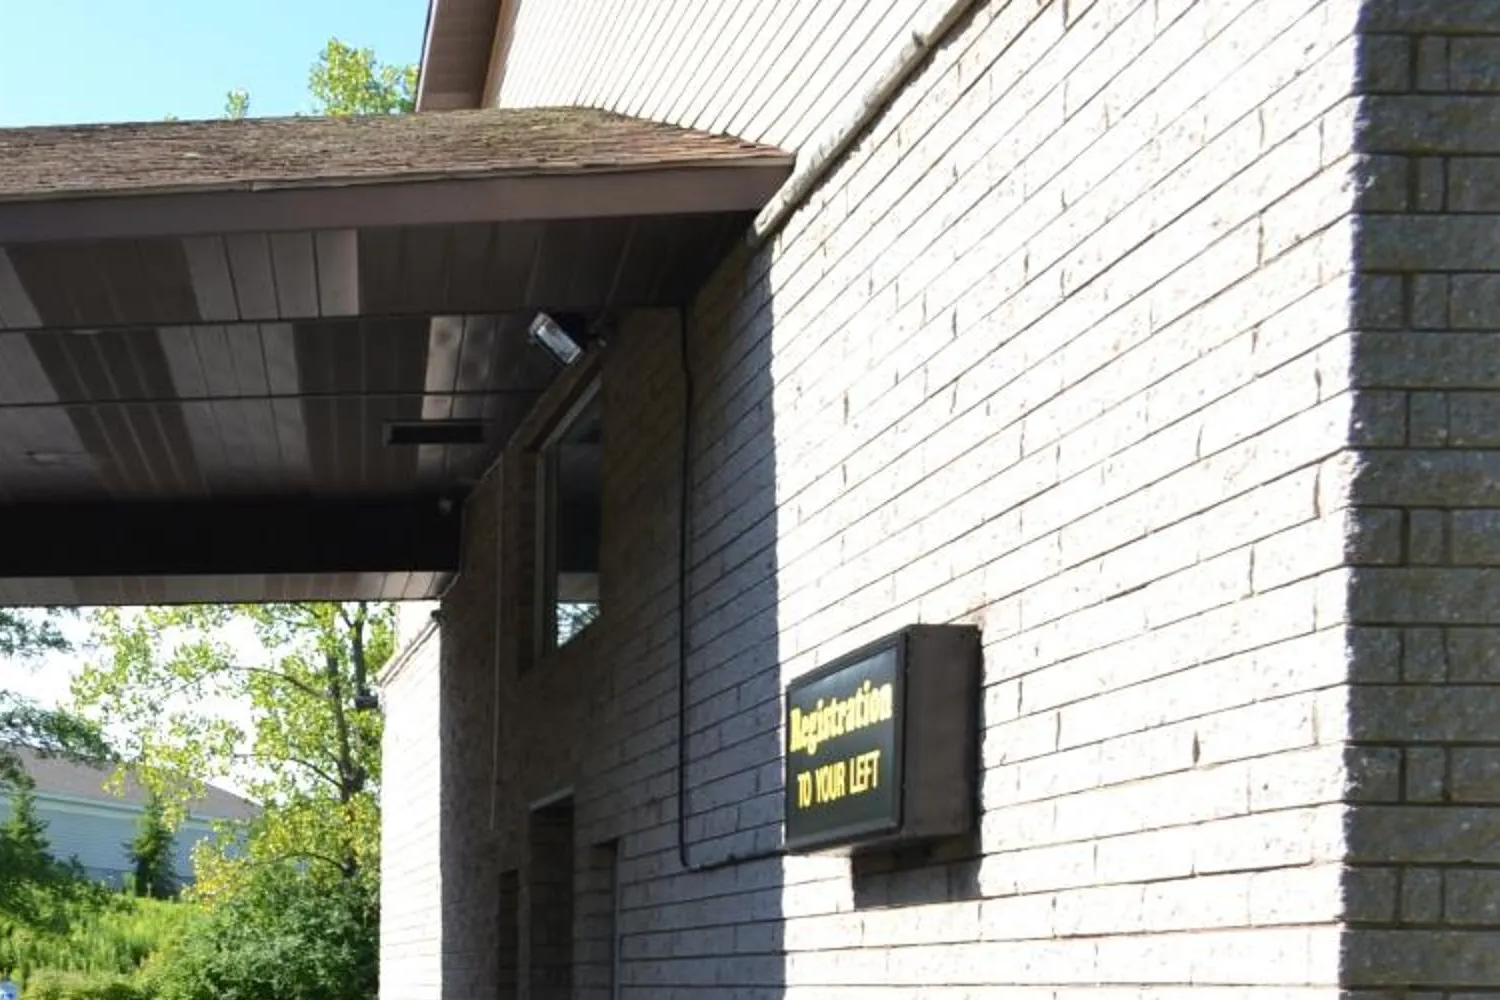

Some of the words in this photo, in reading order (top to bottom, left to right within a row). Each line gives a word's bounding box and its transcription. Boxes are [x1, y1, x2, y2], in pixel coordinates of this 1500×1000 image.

[790, 680, 892, 755] Registration
[797, 771, 813, 808] TO
[815, 762, 845, 803] YOUR
[850, 750, 881, 794] LEFT
